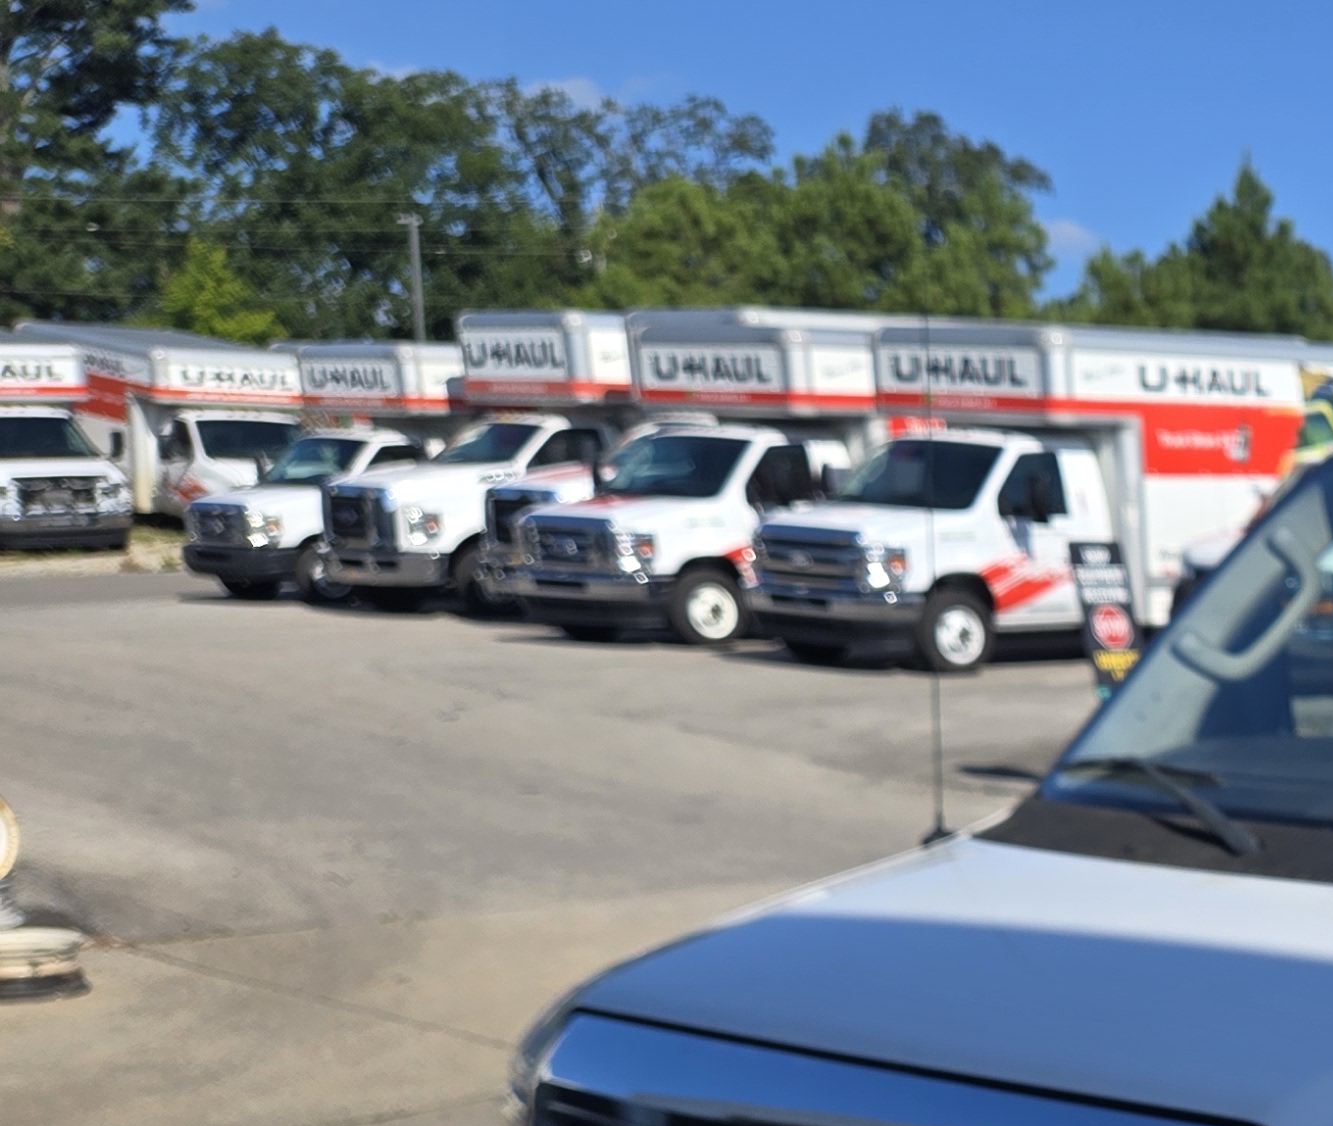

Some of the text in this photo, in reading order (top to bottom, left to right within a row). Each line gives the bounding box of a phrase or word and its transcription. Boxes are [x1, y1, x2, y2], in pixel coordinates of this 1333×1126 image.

[465, 342, 566, 369] U-HAUL
[652, 352, 773, 384] U-HAUL
[890, 353, 1028, 388] U-HAUL
[307, 366, 390, 391] U-HAUL
[1138, 364, 1271, 398] U-HAUL
